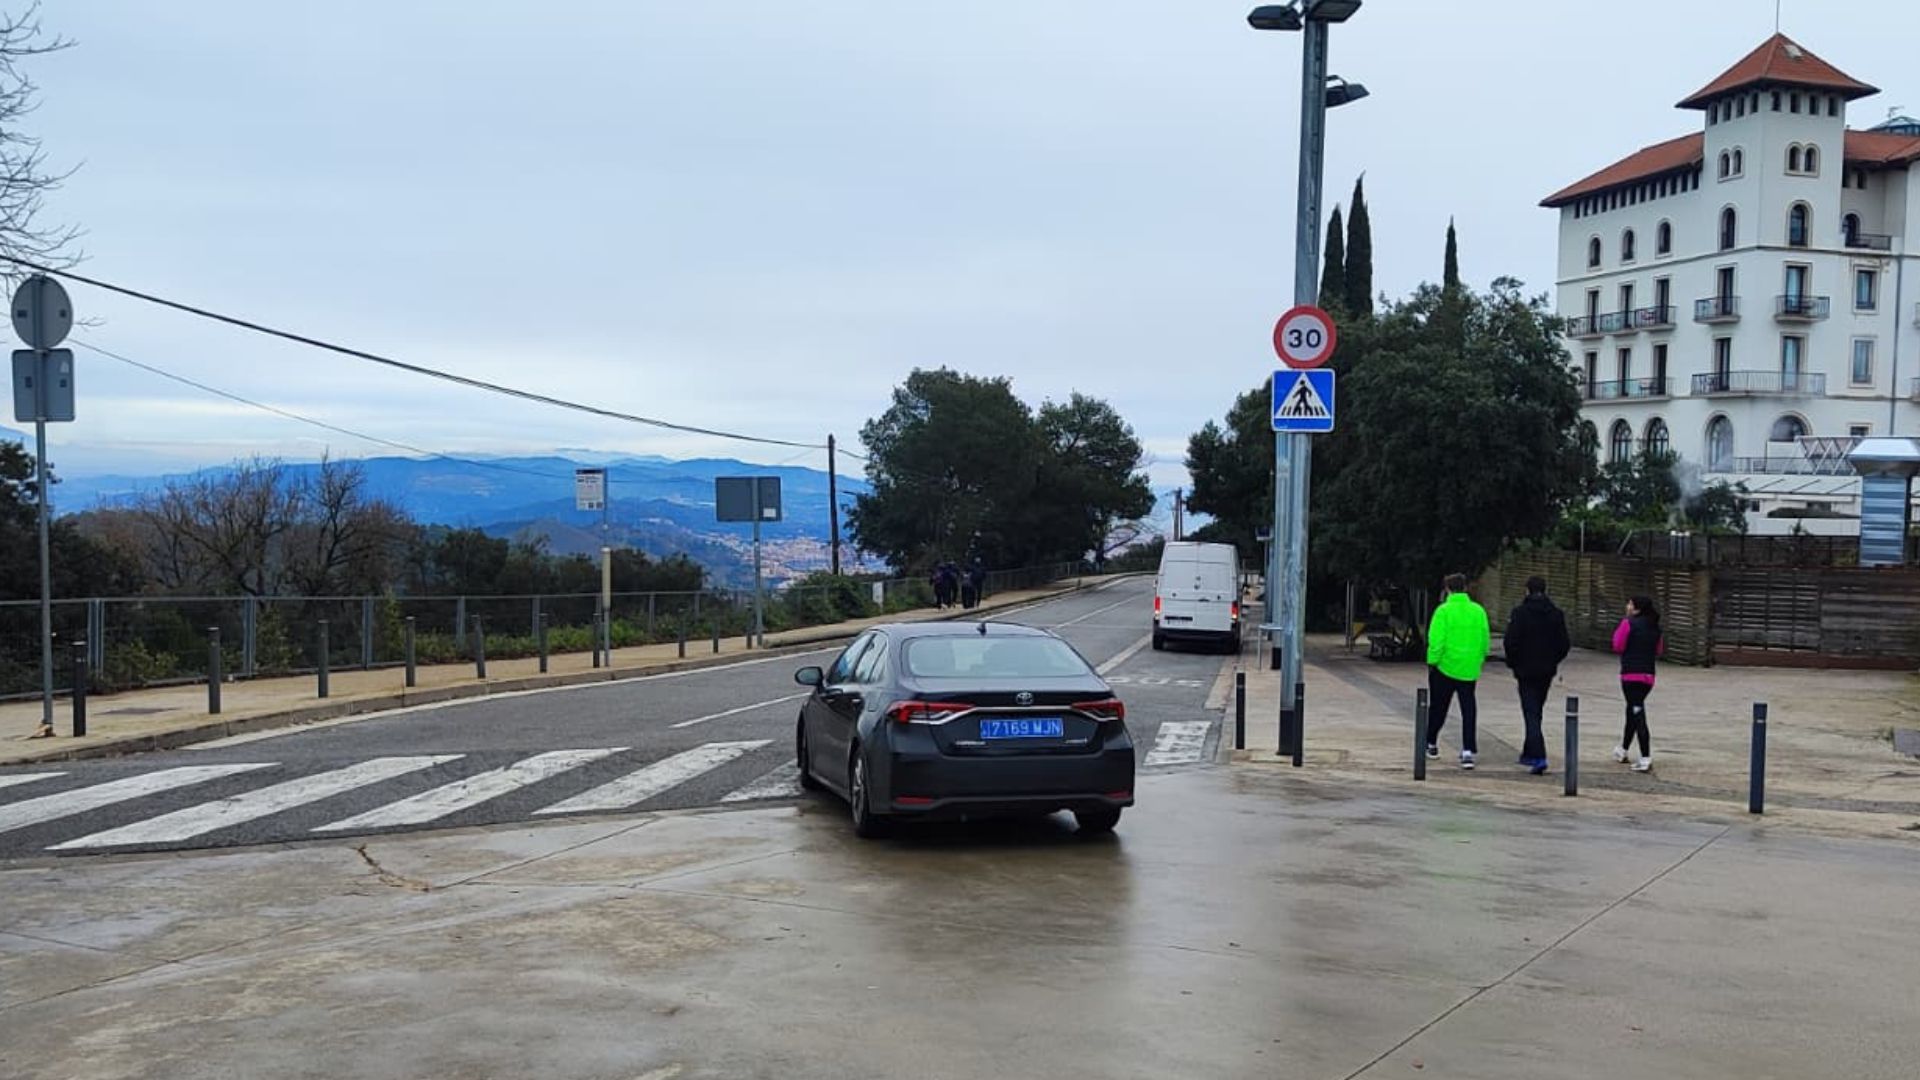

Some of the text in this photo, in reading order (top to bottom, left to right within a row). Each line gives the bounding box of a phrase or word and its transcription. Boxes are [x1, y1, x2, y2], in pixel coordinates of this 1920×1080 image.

[1288, 329, 1321, 348] 30
[992, 719, 1061, 735] 7169 MJN
